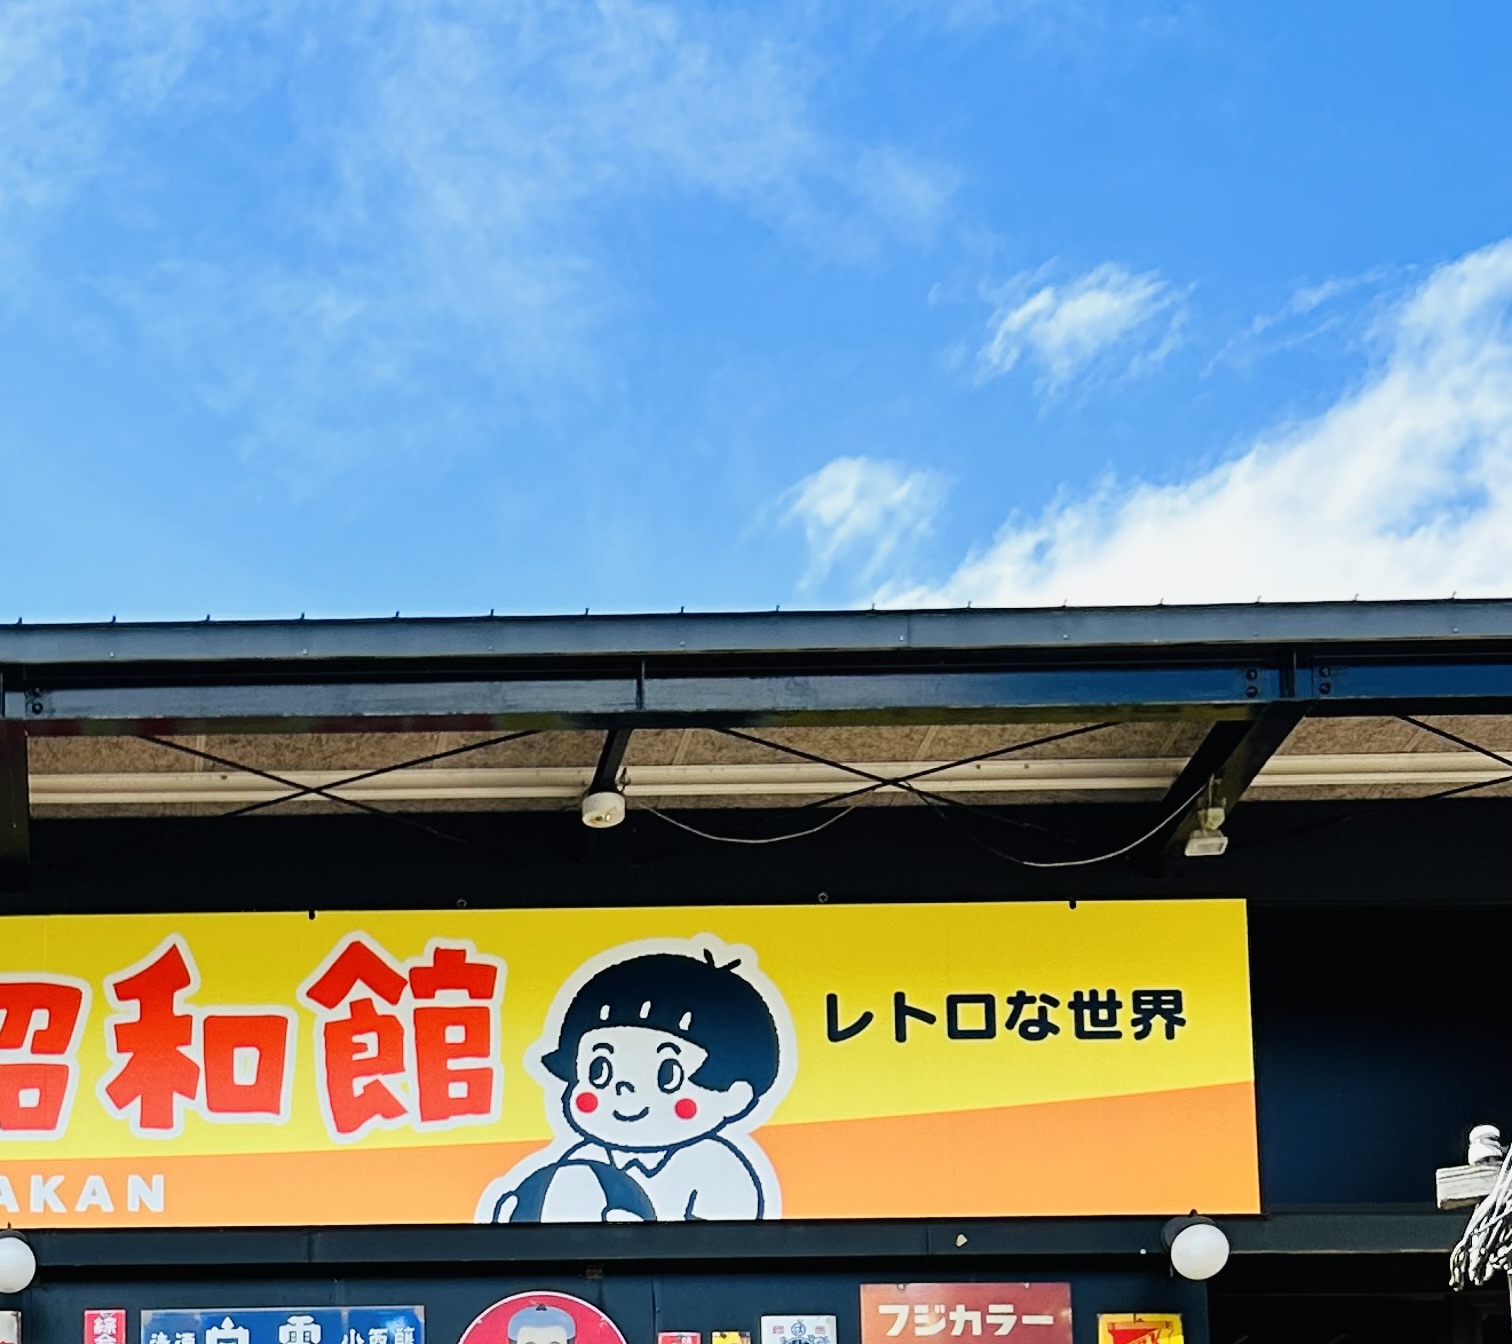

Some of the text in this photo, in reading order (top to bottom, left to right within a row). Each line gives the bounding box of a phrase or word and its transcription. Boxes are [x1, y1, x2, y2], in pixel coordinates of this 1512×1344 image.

[824, 986, 1187, 1044] レトロな世界
[877, 1303, 1055, 1337] フジカラー
